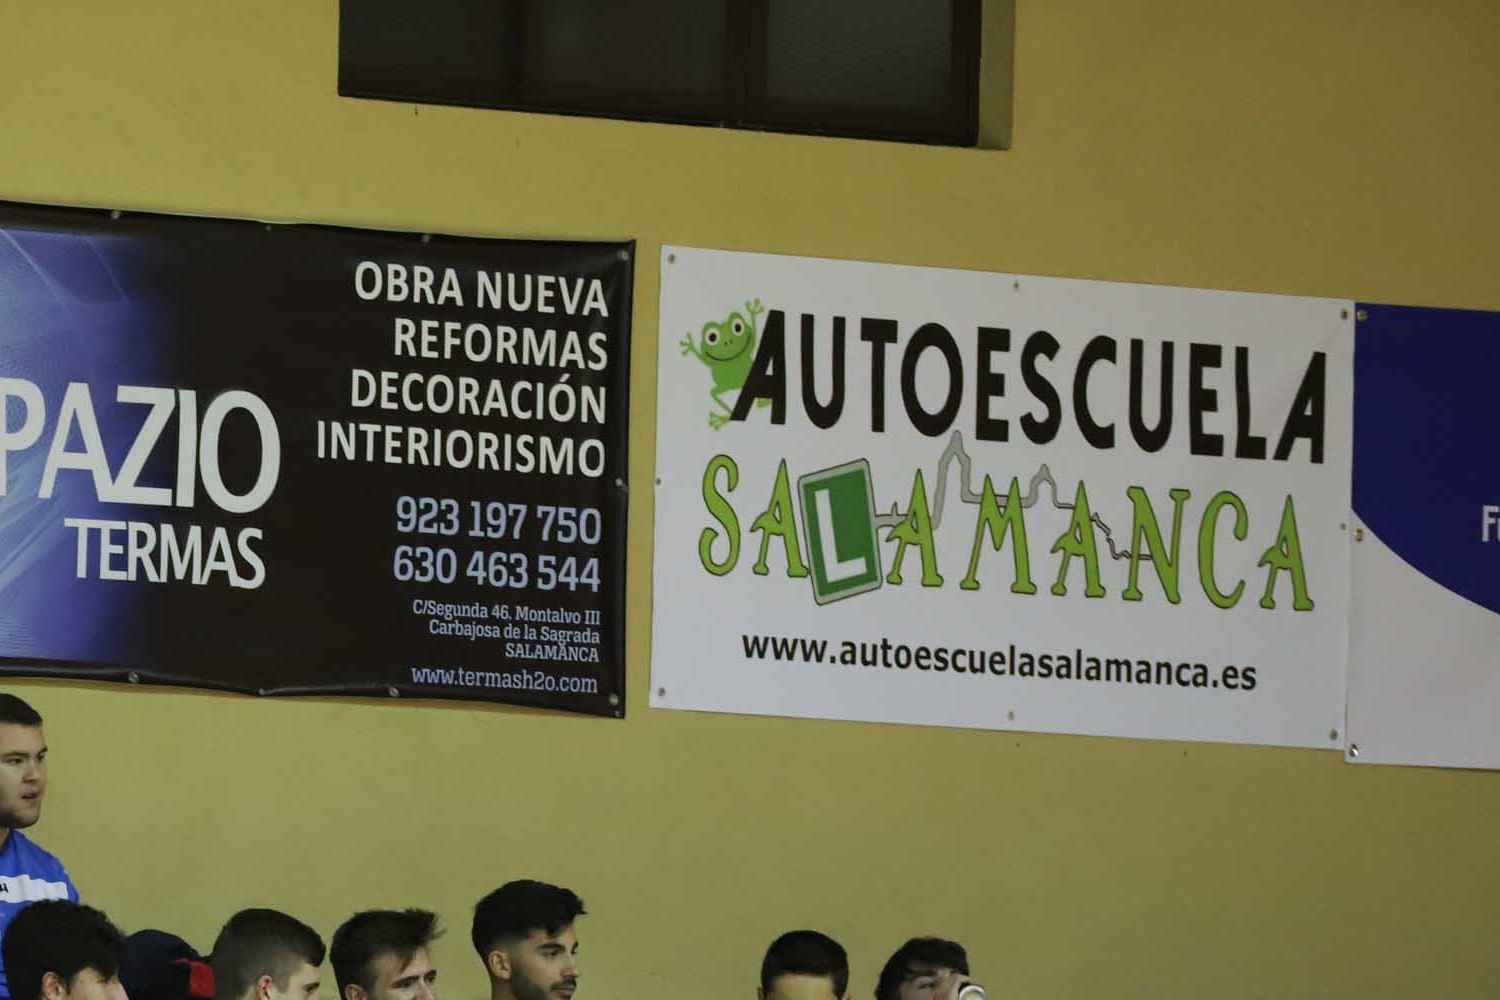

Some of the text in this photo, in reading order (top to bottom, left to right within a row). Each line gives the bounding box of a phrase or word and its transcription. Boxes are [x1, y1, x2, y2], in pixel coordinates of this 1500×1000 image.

[355, 261, 609, 317] OBRA NUEVA
[394, 318, 608, 371] REFORMAS
[351, 368, 606, 424] DECORACIÓN
[728, 308, 1327, 464] AUTOESCUELA
[317, 420, 605, 477] INTERIORISMO
[396, 496, 601, 544] 923 197 750
[698, 453, 1315, 612] SALAMANCA
[64, 518, 265, 590] TERMAS
[393, 545, 601, 592] 630 463 544
[412, 600, 488, 620] C/Segunda
[515, 606, 581, 624] Montalvo
[584, 610, 600, 625] III
[429, 619, 600, 645] Carbajosa de la Sagrada
[505, 643, 599, 662] SALAMANCA
[741, 631, 1257, 691] www.autoescuelasalamanca.es
[412, 667, 598, 693] www.termash2o.com
